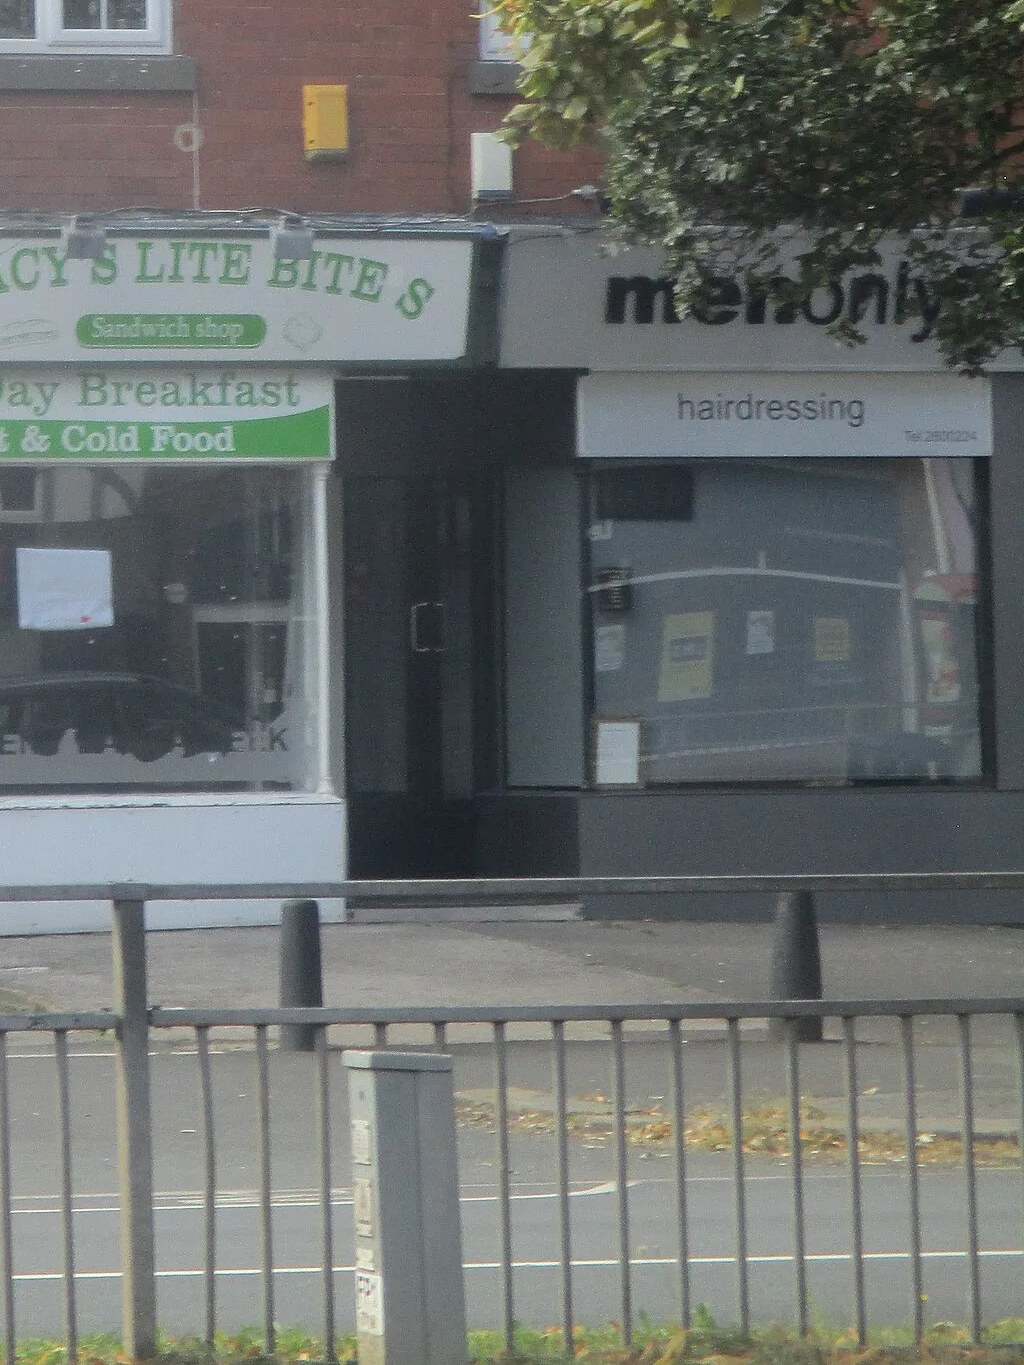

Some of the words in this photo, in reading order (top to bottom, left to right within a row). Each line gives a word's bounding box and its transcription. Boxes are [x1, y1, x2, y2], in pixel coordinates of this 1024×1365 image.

[135, 240, 252, 285] LITE
[91, 316, 190, 338] Sandwich
[195, 316, 244, 345] shop
[76, 371, 302, 408] Breakfast
[677, 393, 866, 427] hairdressing
[20, 426, 52, 453] &
[60, 424, 140, 453] Cold
[150, 424, 237, 453] Food
